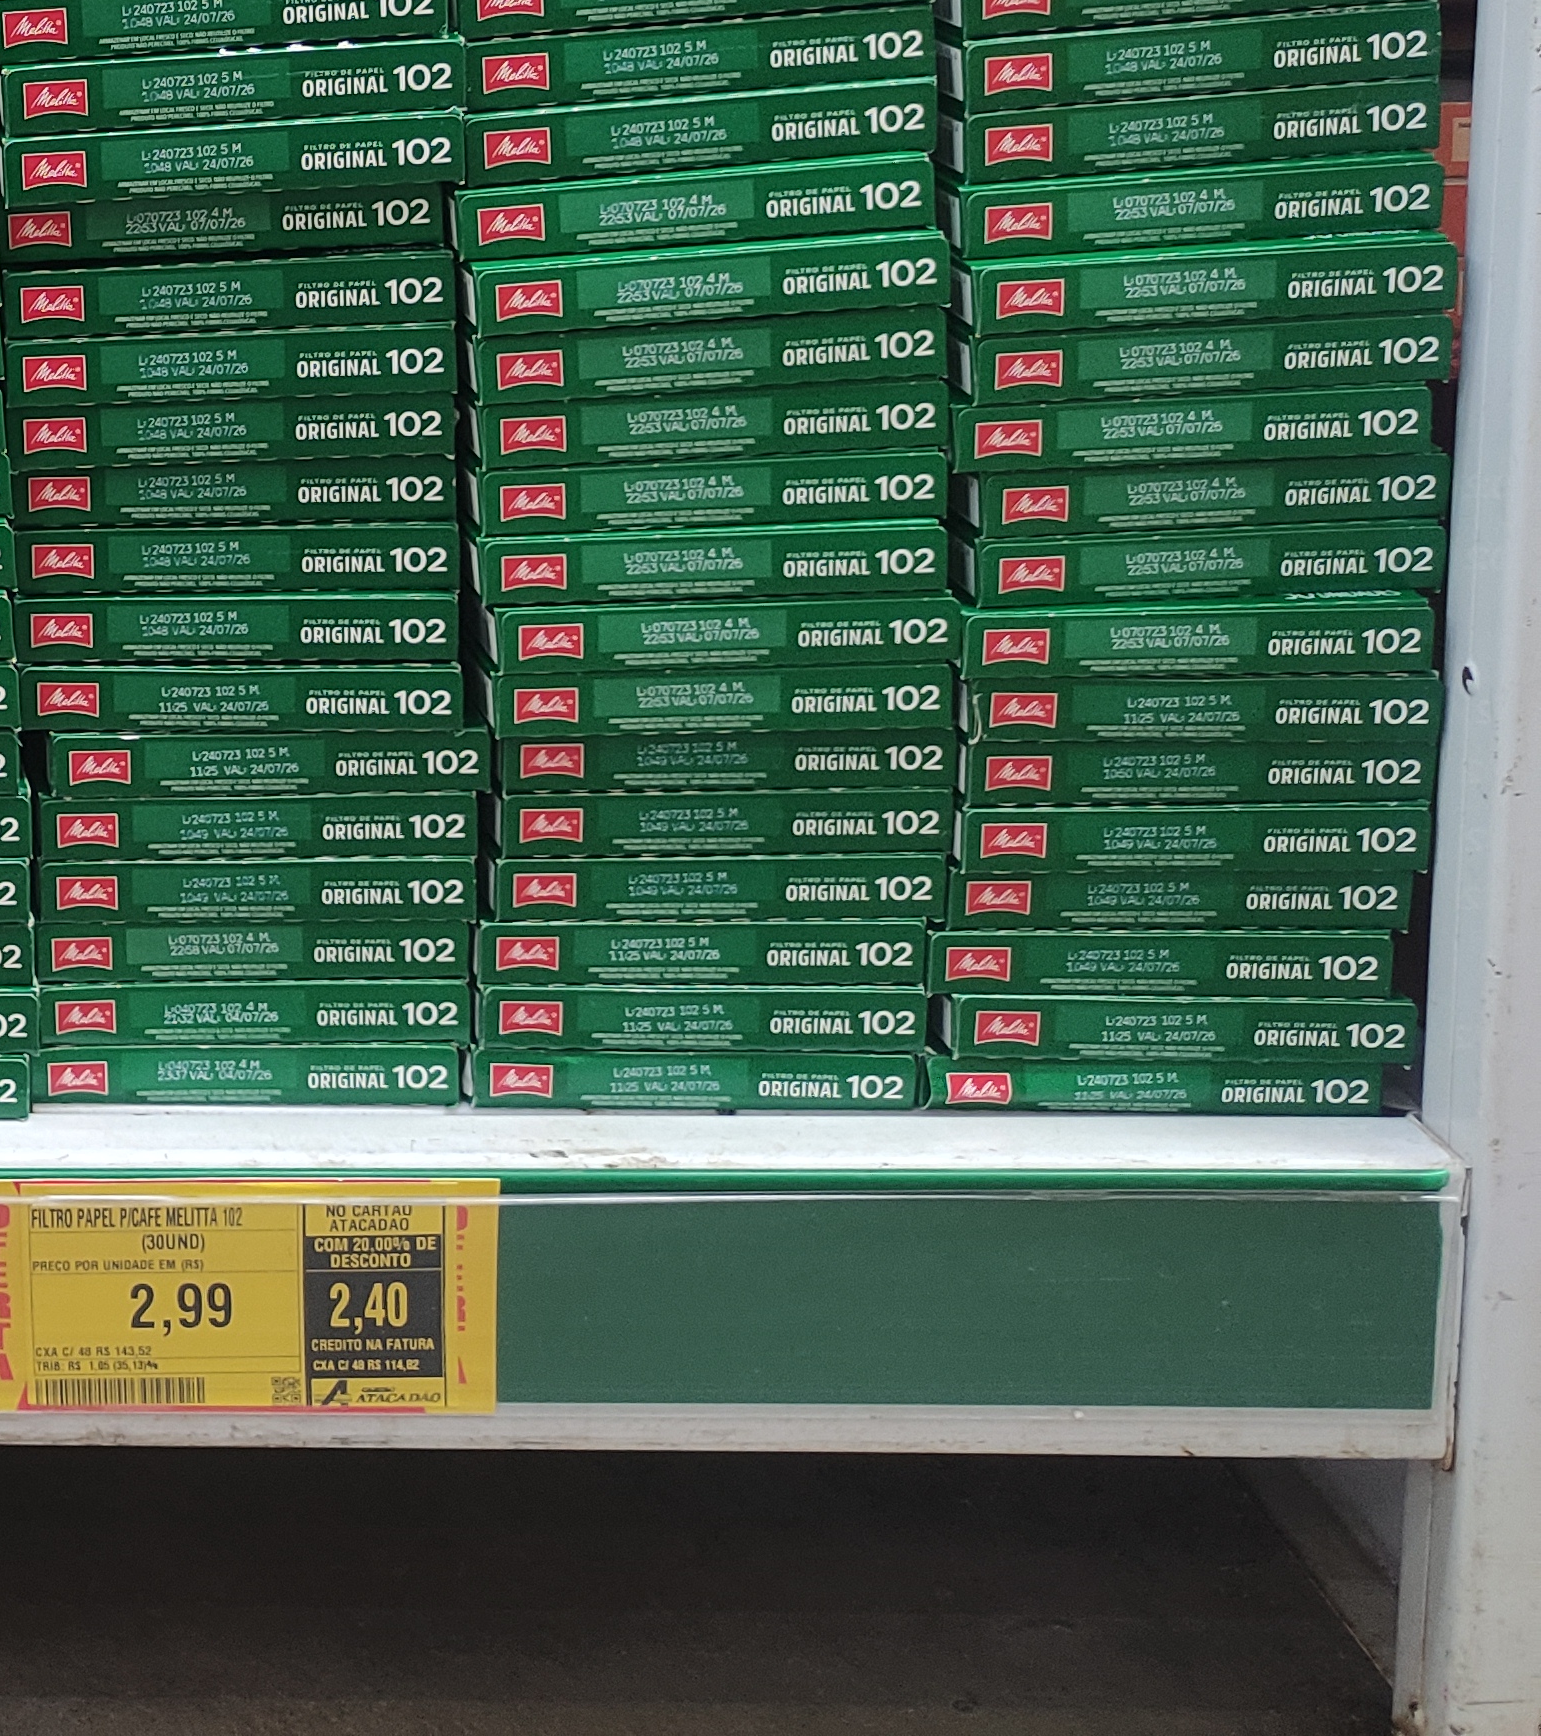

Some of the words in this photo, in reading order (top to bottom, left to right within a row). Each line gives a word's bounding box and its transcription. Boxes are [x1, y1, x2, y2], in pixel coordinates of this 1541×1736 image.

[1221, 1082, 1306, 1104] ORIGINAL
[1313, 1078, 1371, 1106] 102
[31, 1210, 72, 1228] FILTRO
[77, 1209, 116, 1227] PAPEL
[120, 1208, 162, 1227] P/CAFE
[166, 1208, 217, 1226] MELITTA
[223, 1207, 242, 1226] 102
[130, 1283, 232, 1336] 2,99
[329, 1282, 408, 1334] 2,40
